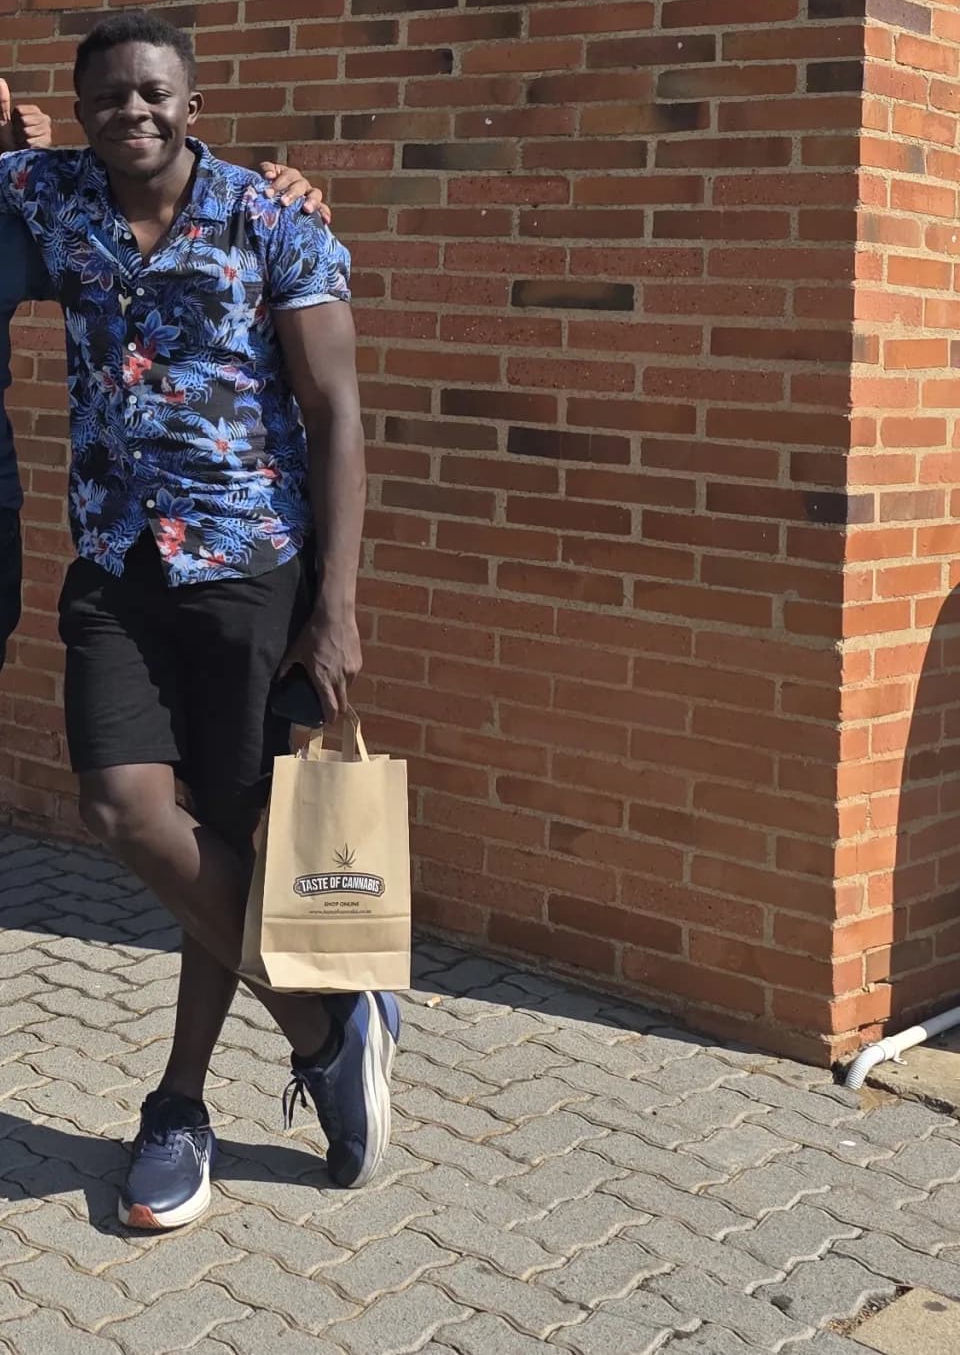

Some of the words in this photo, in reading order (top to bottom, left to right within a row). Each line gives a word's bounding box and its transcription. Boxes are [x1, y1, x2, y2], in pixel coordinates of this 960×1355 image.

[300, 877, 329, 893] TASTE
[330, 876, 341, 888] OF
[342, 876, 380, 893] CANNABIS
